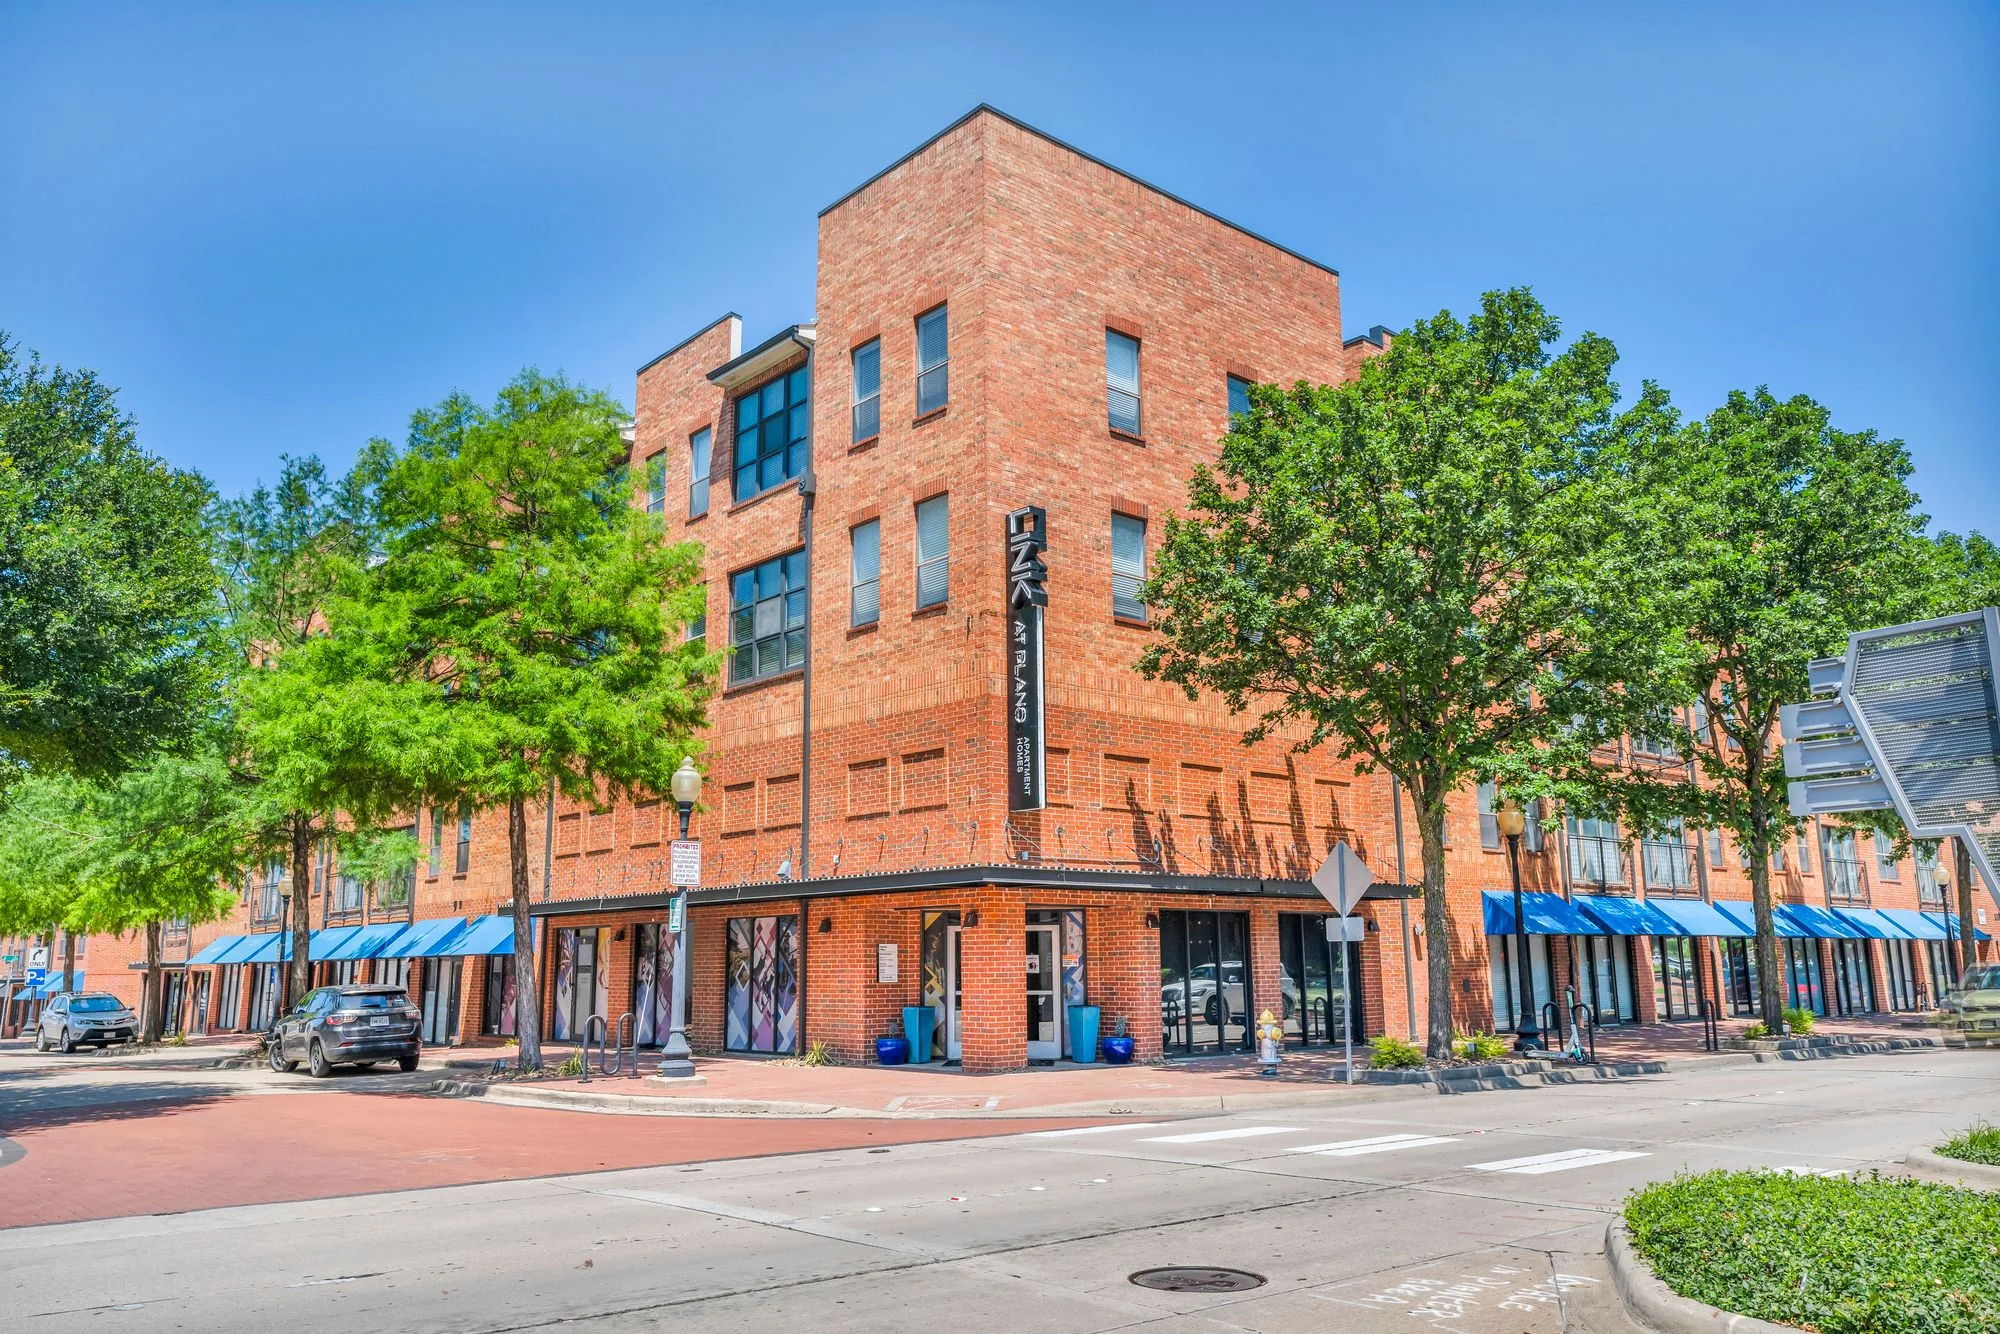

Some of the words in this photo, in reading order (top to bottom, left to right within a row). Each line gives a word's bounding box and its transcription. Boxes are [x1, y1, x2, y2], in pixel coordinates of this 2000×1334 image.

[1009, 507, 1034, 605] LINK
[1013, 620, 1026, 645] AT
[1014, 649, 1027, 724] PLANO
[1023, 736, 1031, 796] APARTMENT
[26, 971, 37, 984] P
